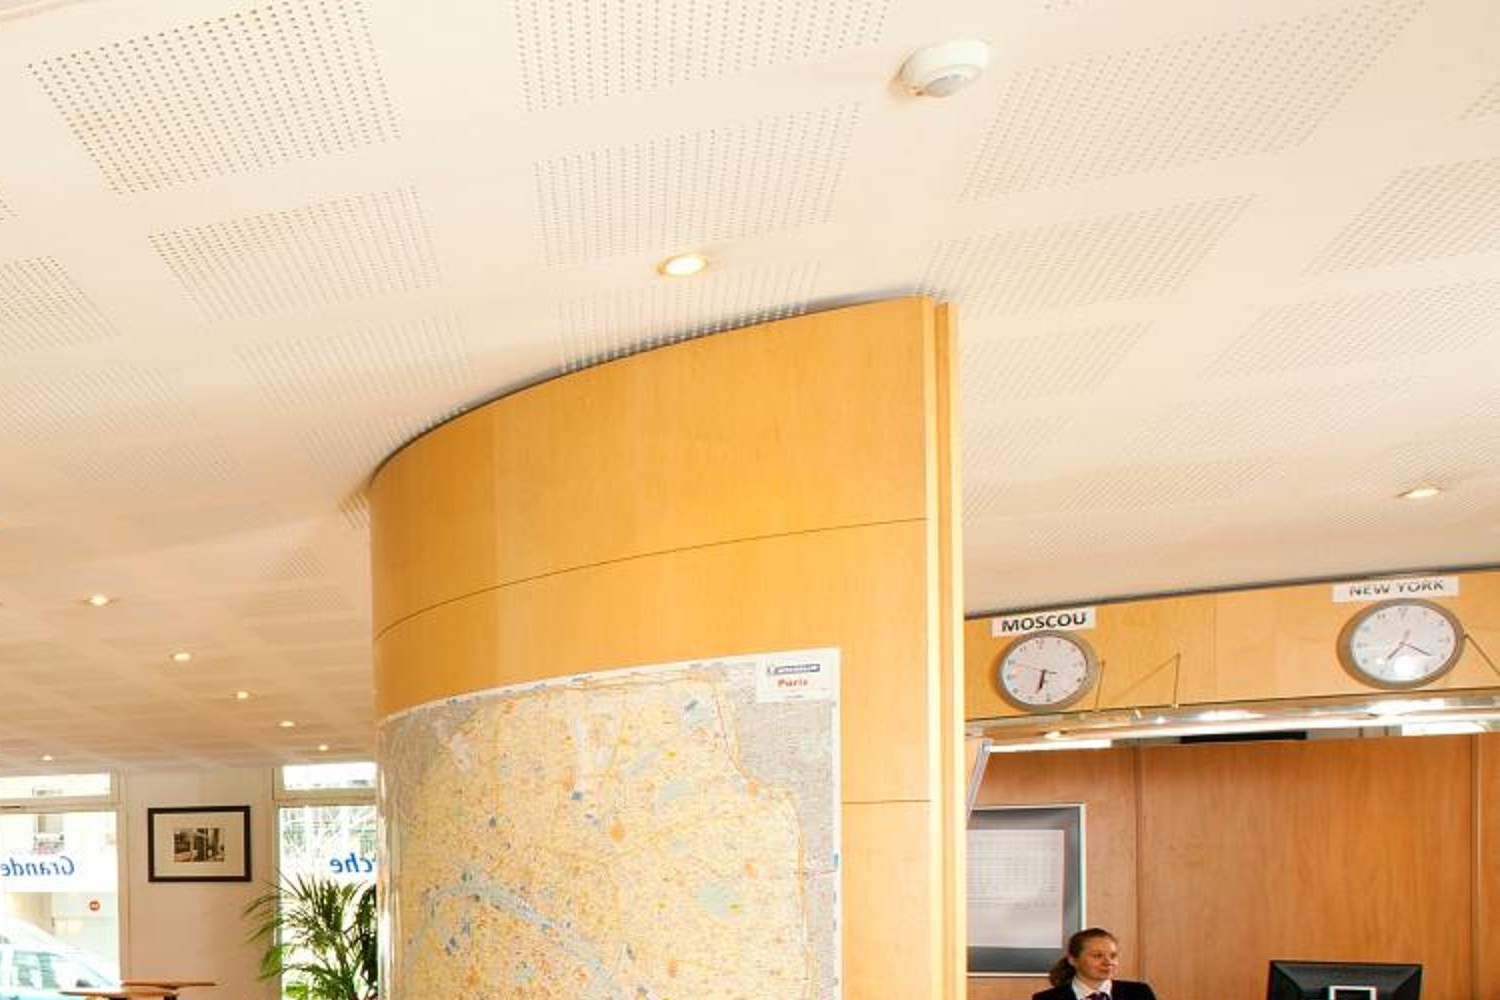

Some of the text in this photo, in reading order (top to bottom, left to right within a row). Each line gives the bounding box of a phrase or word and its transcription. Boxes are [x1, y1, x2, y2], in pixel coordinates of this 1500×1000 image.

[1348, 579, 1445, 597] NEW YORK
[1001, 612, 1087, 632] MOSCOU
